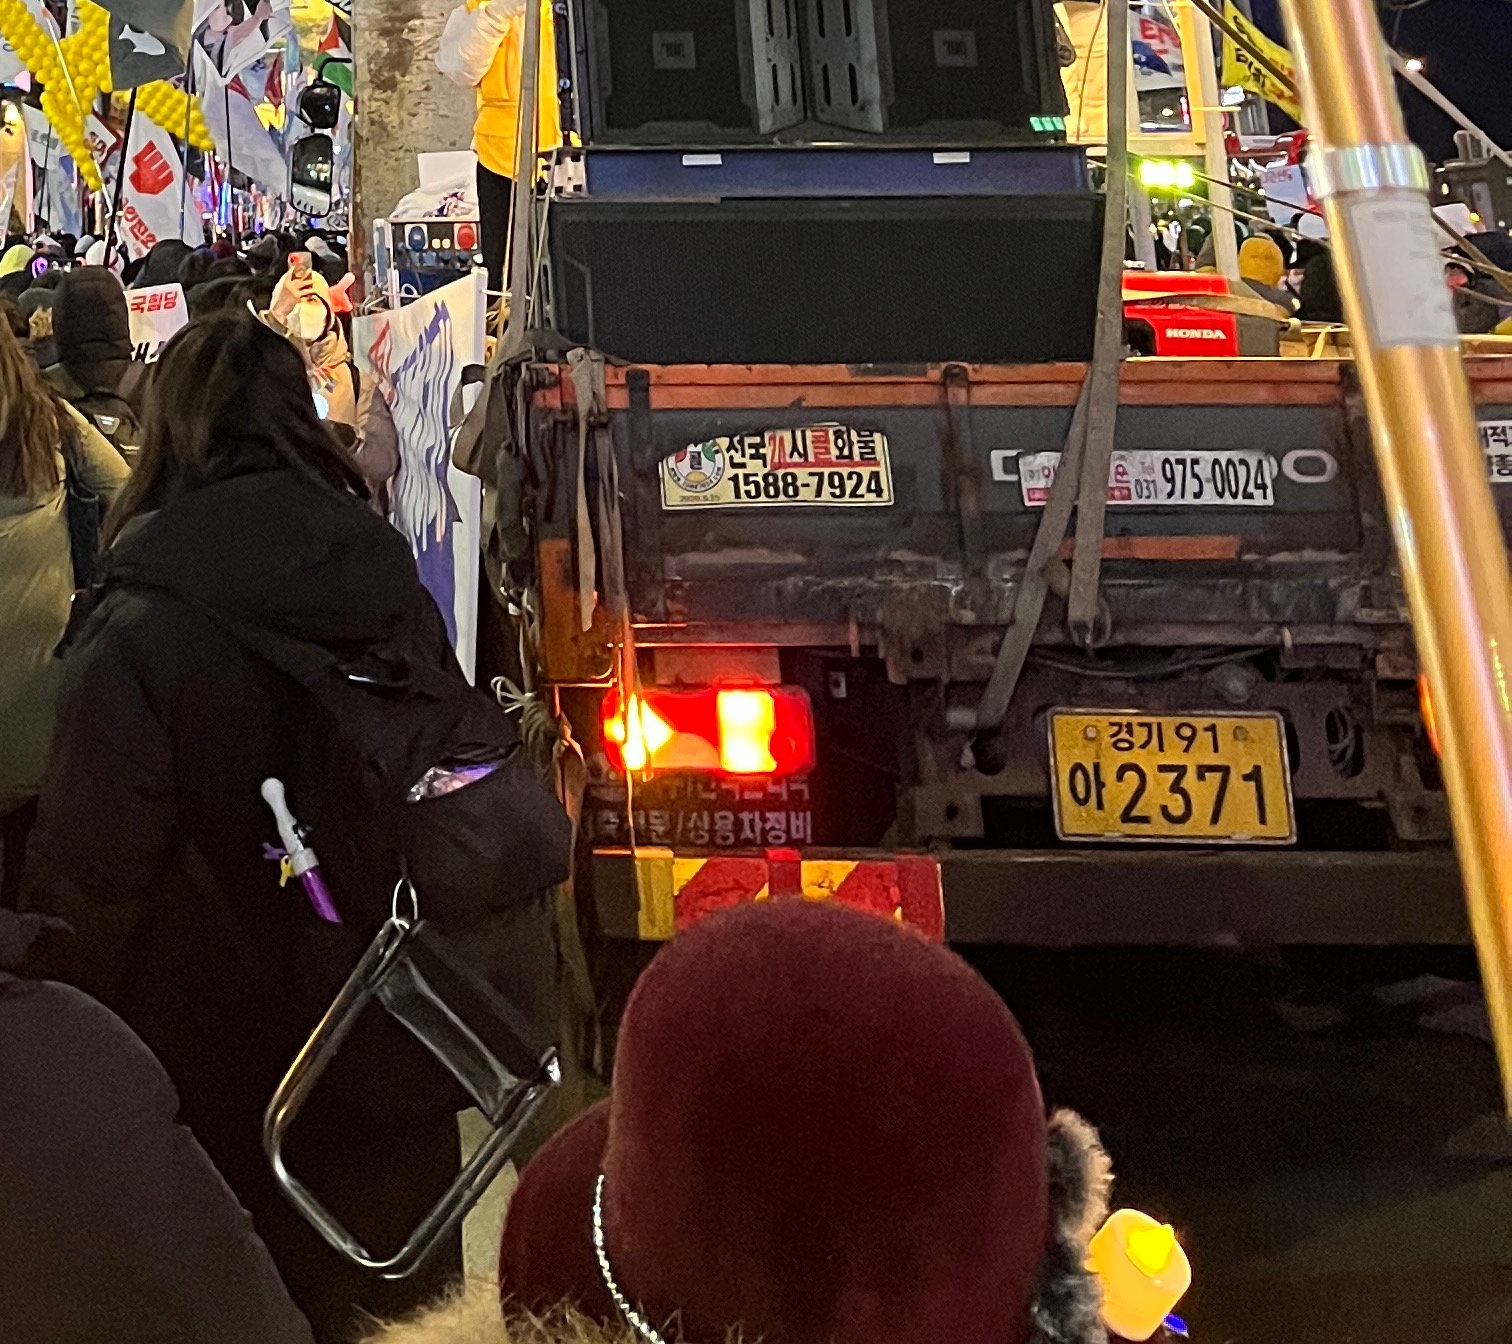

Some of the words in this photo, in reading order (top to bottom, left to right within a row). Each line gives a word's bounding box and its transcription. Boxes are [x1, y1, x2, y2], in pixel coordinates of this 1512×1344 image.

[1165, 328, 1228, 341] HONDA
[727, 470, 885, 500] 1588-7924
[1134, 478, 1158, 500] 031
